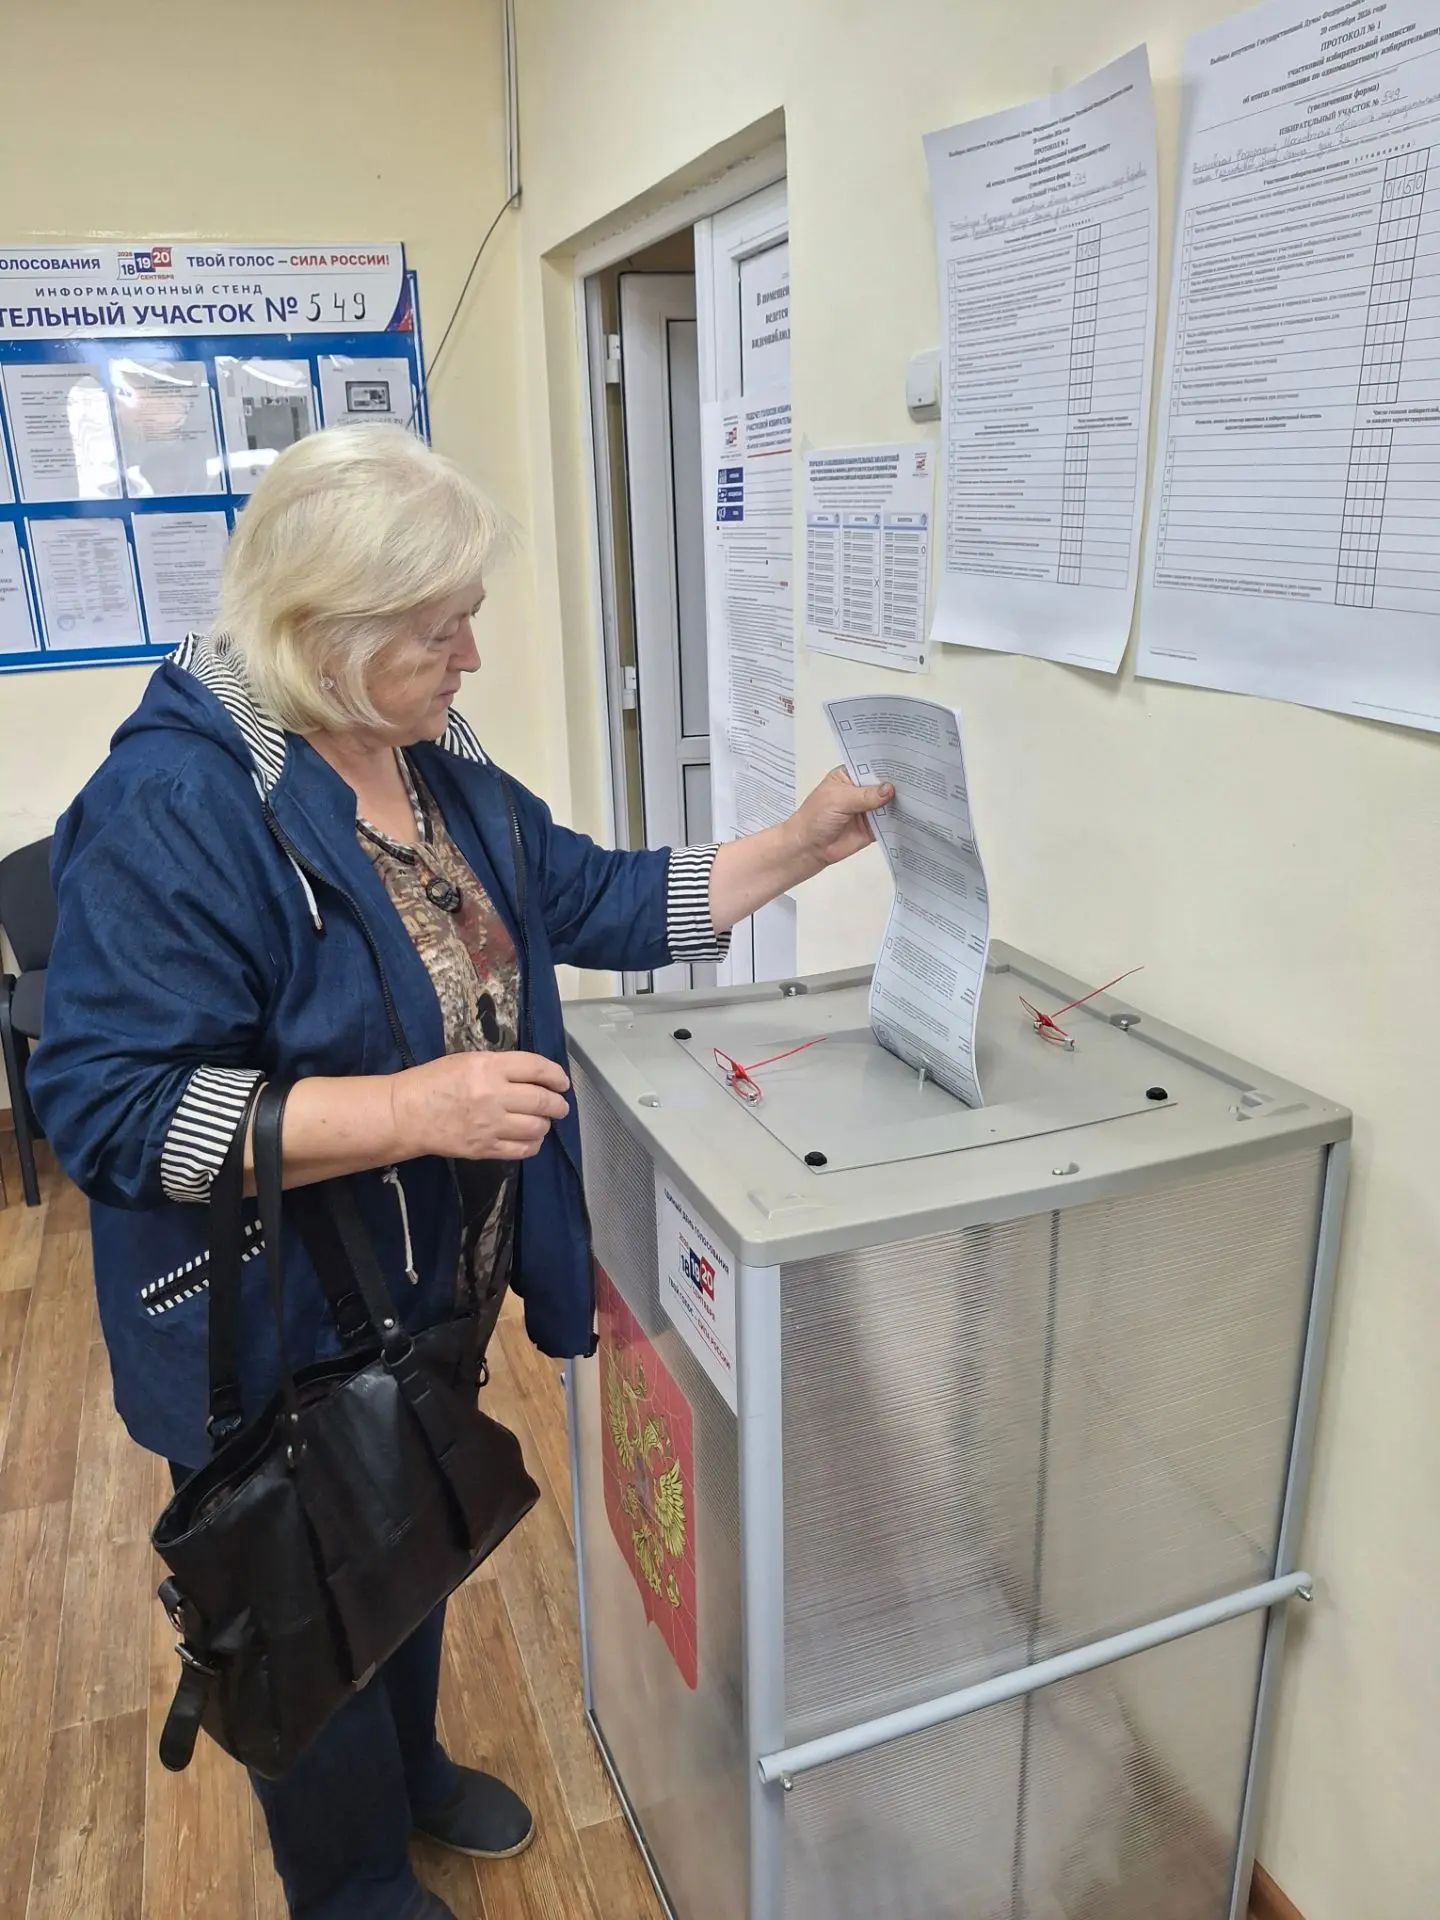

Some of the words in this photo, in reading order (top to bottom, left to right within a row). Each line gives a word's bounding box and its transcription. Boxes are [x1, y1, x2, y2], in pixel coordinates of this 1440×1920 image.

[1320, 25, 1367, 52] ПРОТОКОЛ
[0, 258, 100, 271] ОЛОСОВАНИЯ
[136, 256, 151, 270] 19
[152, 251, 170, 264] 20
[187, 253, 226, 268] ТВОЙ
[229, 256, 275, 267] ГОЛОС
[290, 255, 327, 267] СИЛА
[330, 254, 389, 266] РОССИИ!
[120, 263, 136, 276] 18
[35, 283, 204, 298] ИНФОРМАЦИОННЫЙ
[212, 284, 264, 296] СТЕНД
[132, 303, 256, 326] УЧАСТОК
[265, 296, 299, 323] №
[305, 291, 367, 323] 549
[681, 1254, 690, 1278] 18
[701, 1263, 713, 1291] 20
